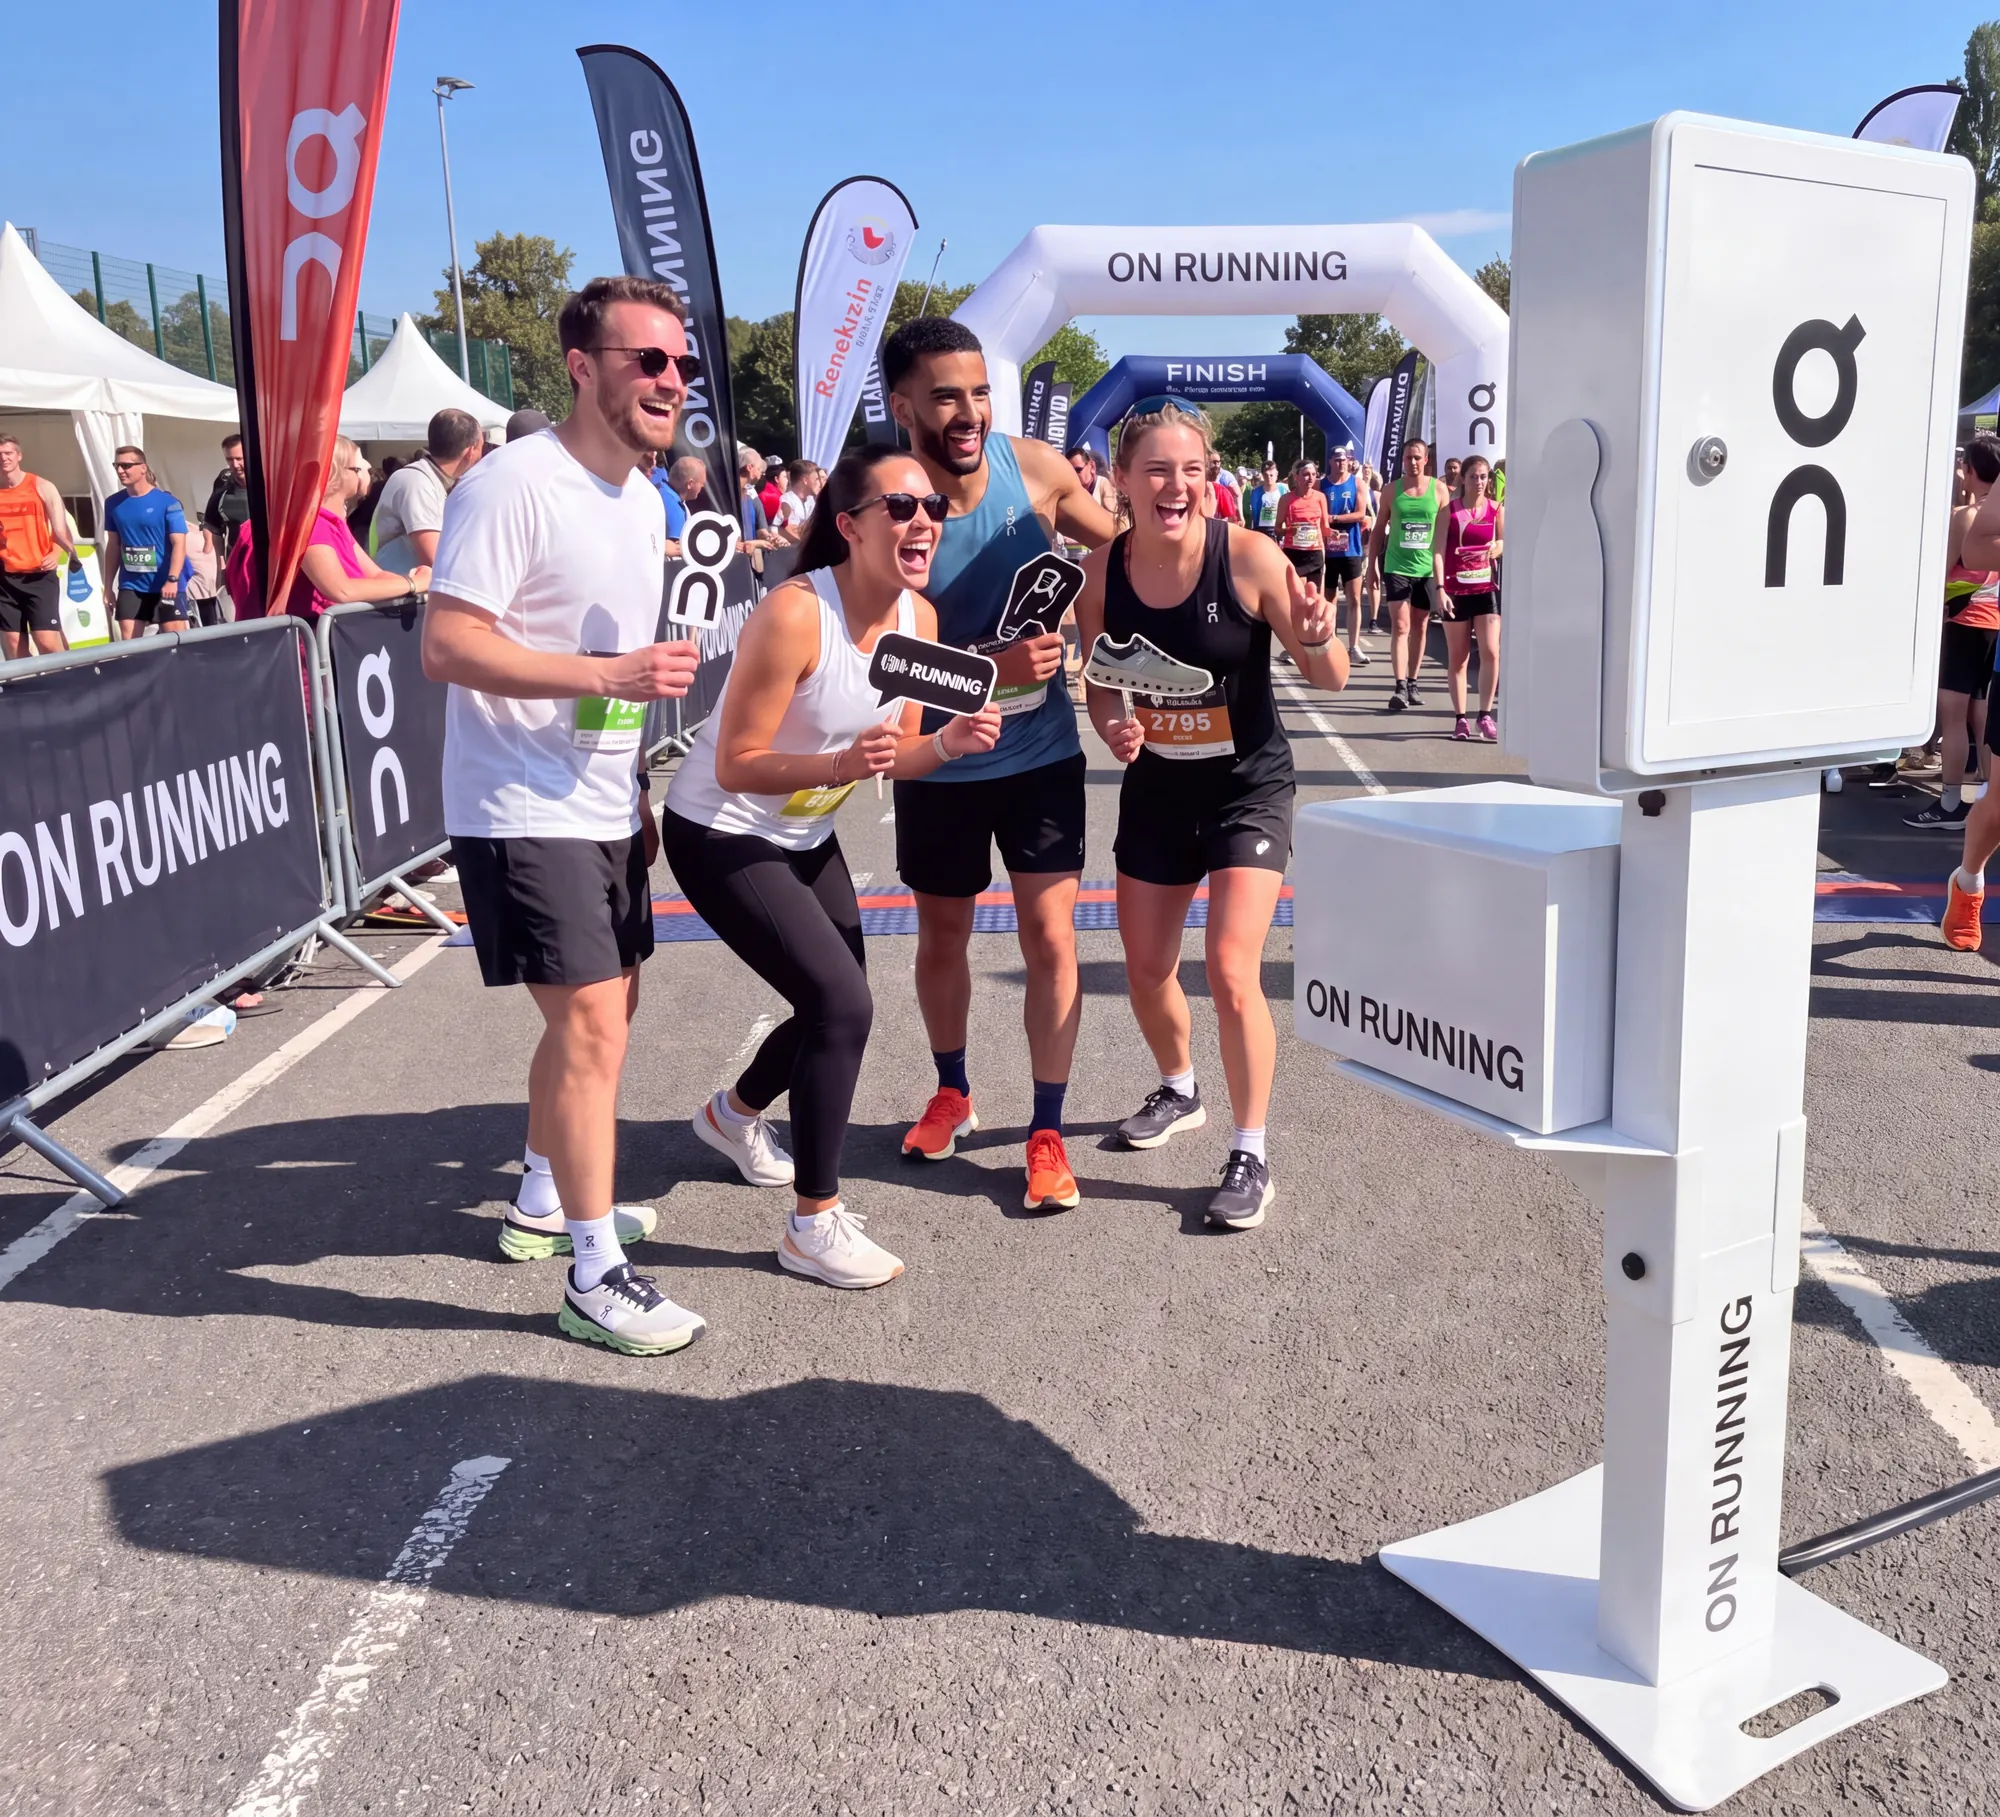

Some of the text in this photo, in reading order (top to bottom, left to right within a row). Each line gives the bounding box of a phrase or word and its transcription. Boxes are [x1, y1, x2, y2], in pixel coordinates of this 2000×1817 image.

[1108, 251, 1347, 282] ON RUNNING
[1166, 364, 1267, 382] FINISH
[1150, 713, 1211, 732] 2795
[0, 742, 290, 947] ON RUNNING
[1306, 979, 1524, 1093] ON RUNNING
[1705, 1295, 1753, 1632] ON RUNNING
